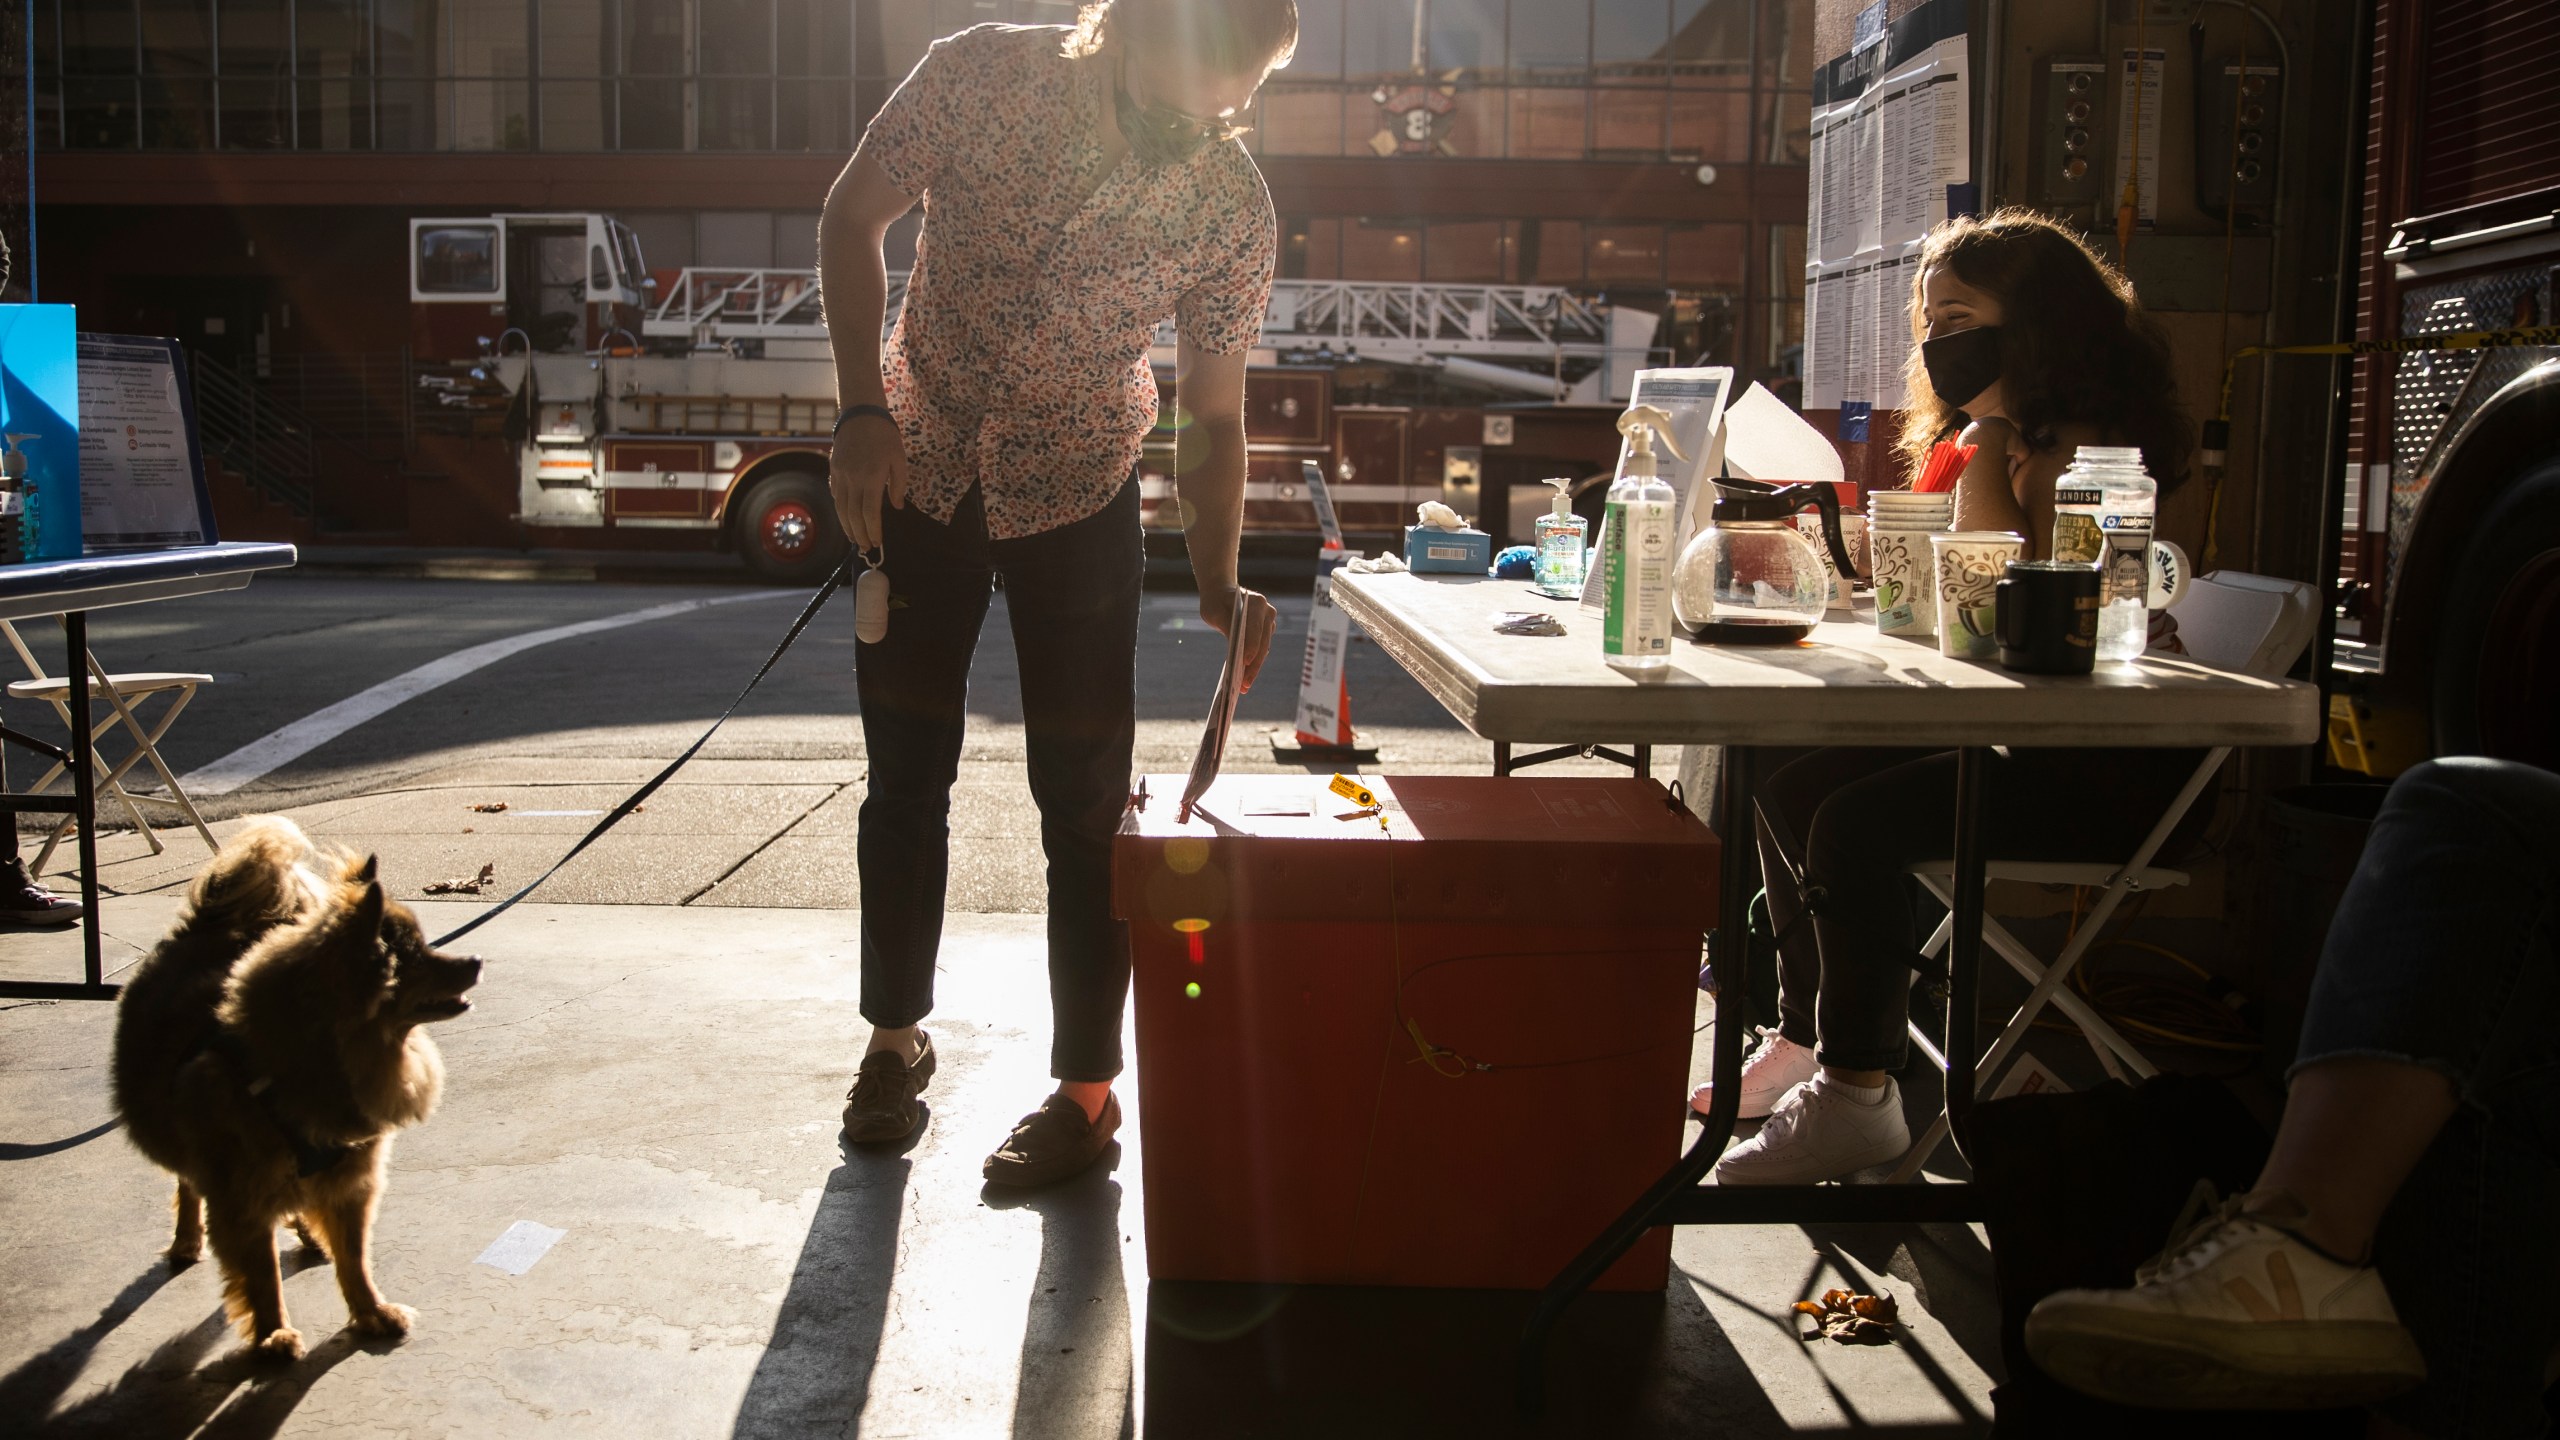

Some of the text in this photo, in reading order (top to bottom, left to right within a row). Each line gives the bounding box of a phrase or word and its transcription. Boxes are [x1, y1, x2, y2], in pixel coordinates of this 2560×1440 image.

[1838, 57, 1857, 87] VOTER
[1857, 49, 1870, 78] BILL
[2125, 80, 2158, 88] CATION
[1406, 109, 1432, 140] 8
[1615, 510, 1625, 551] Surface
[1604, 518, 1617, 618] sanitizer
